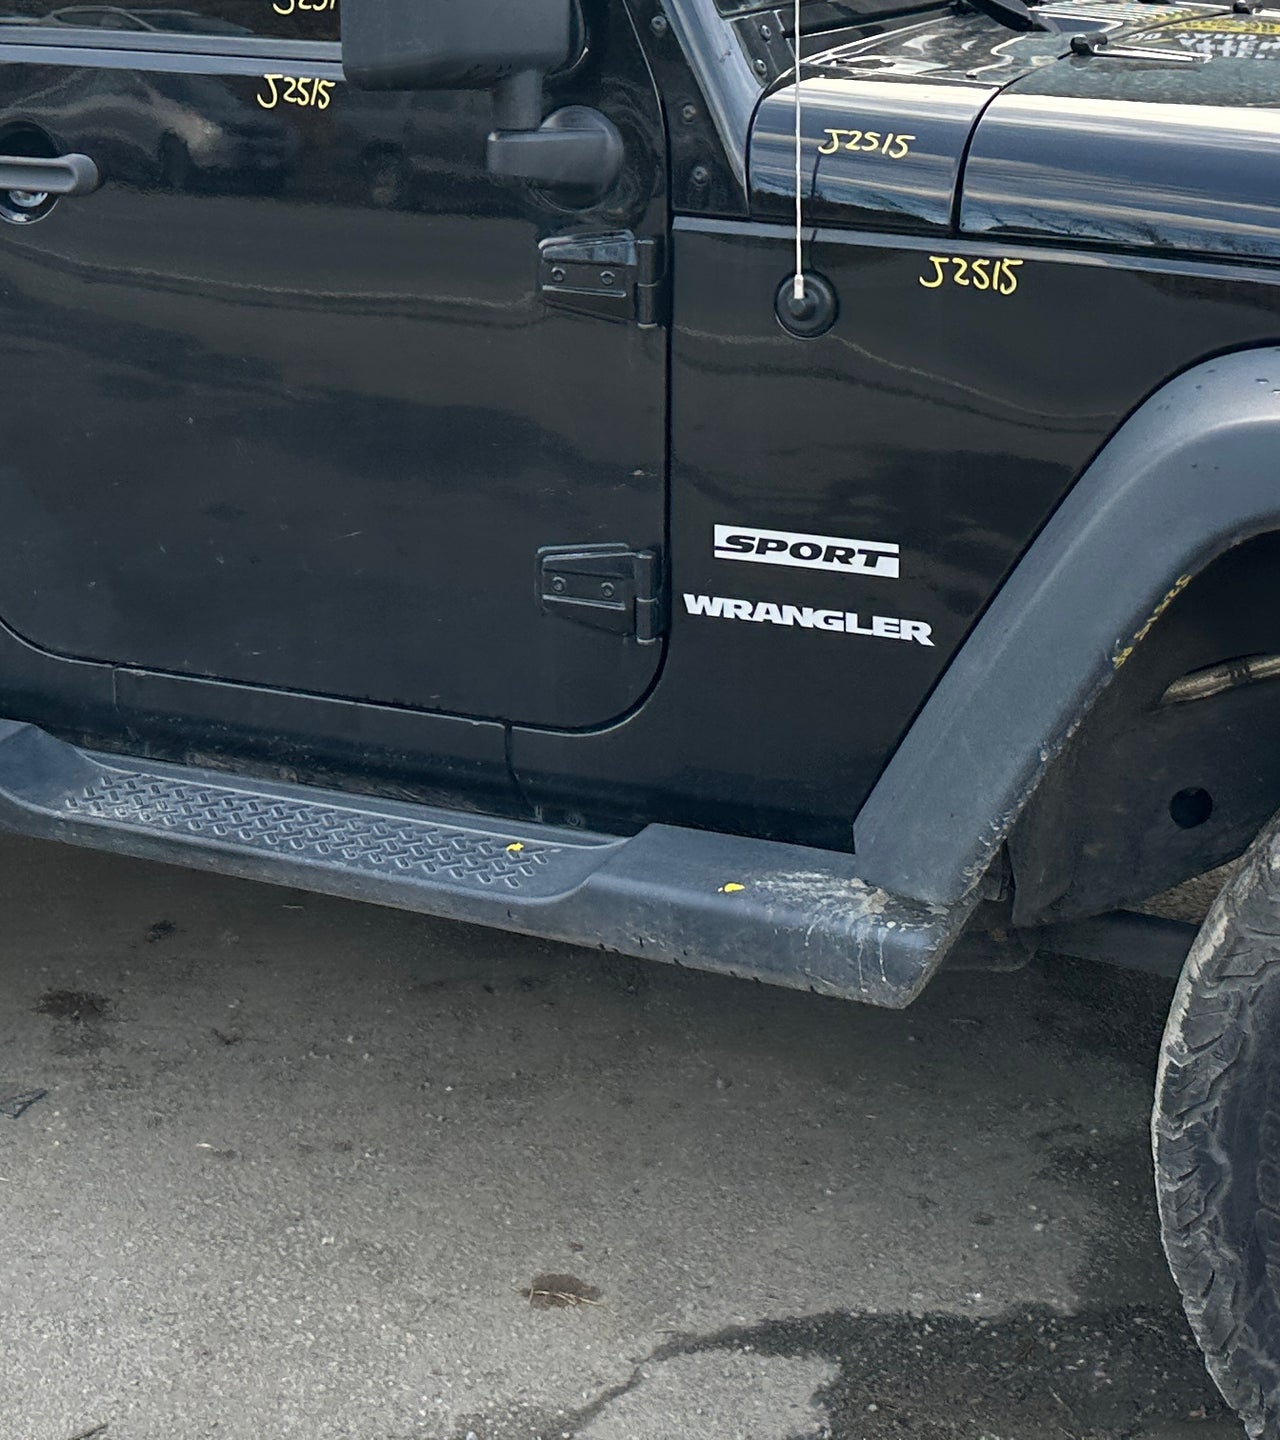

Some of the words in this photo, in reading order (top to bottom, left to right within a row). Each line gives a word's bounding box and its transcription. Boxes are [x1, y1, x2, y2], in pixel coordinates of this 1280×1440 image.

[256, 73, 337, 110] J2515
[817, 128, 917, 159] J2515
[918, 255, 1024, 296] J2515
[724, 533, 890, 569] SPORT
[682, 593, 936, 648] WRANGLER
